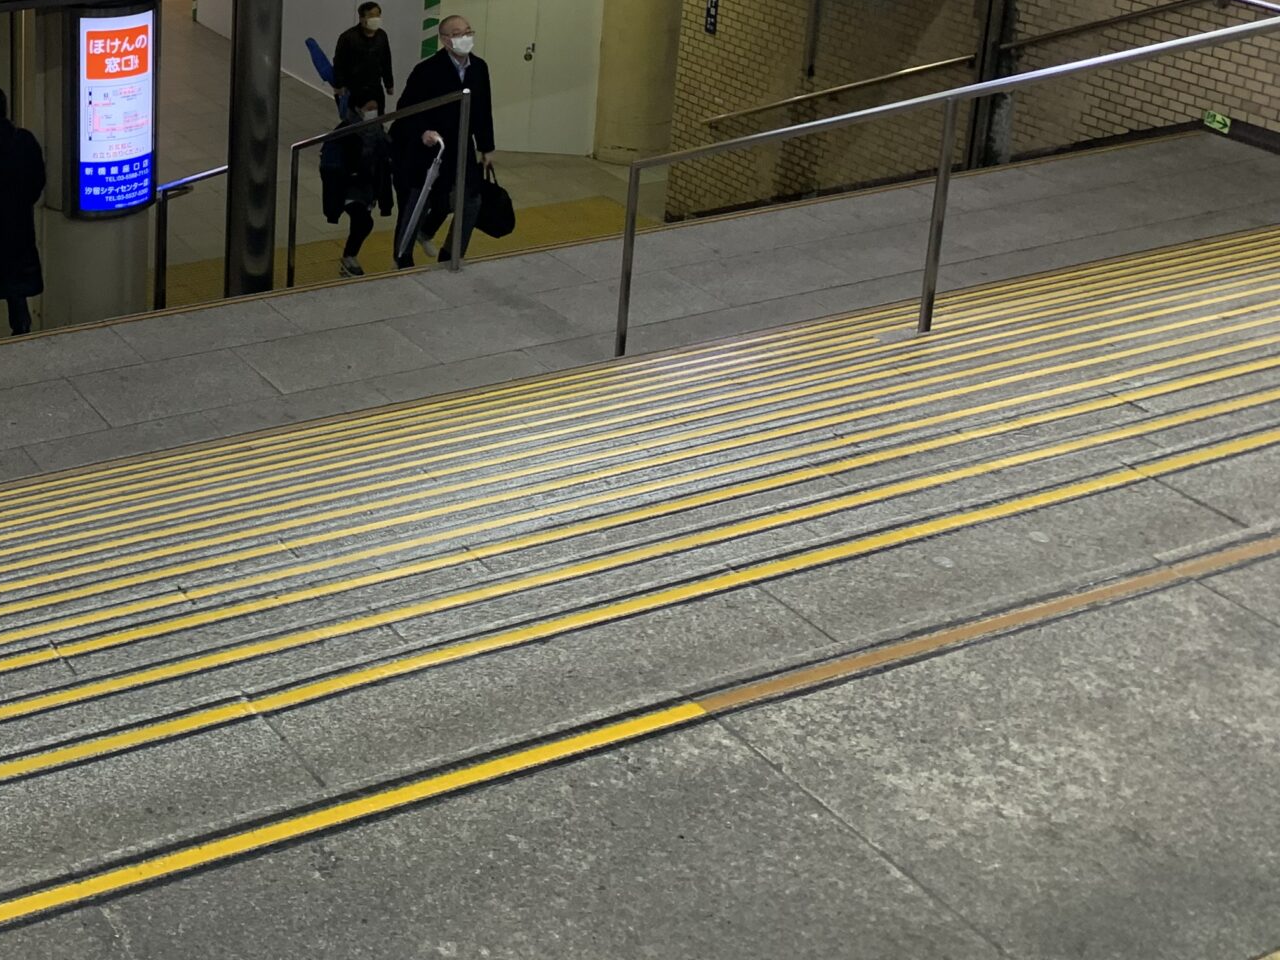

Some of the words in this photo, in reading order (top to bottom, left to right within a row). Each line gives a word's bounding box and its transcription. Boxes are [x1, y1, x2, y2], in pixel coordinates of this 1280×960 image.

[89, 34, 148, 54] ほけんの
[105, 55, 134, 73] 窓口
